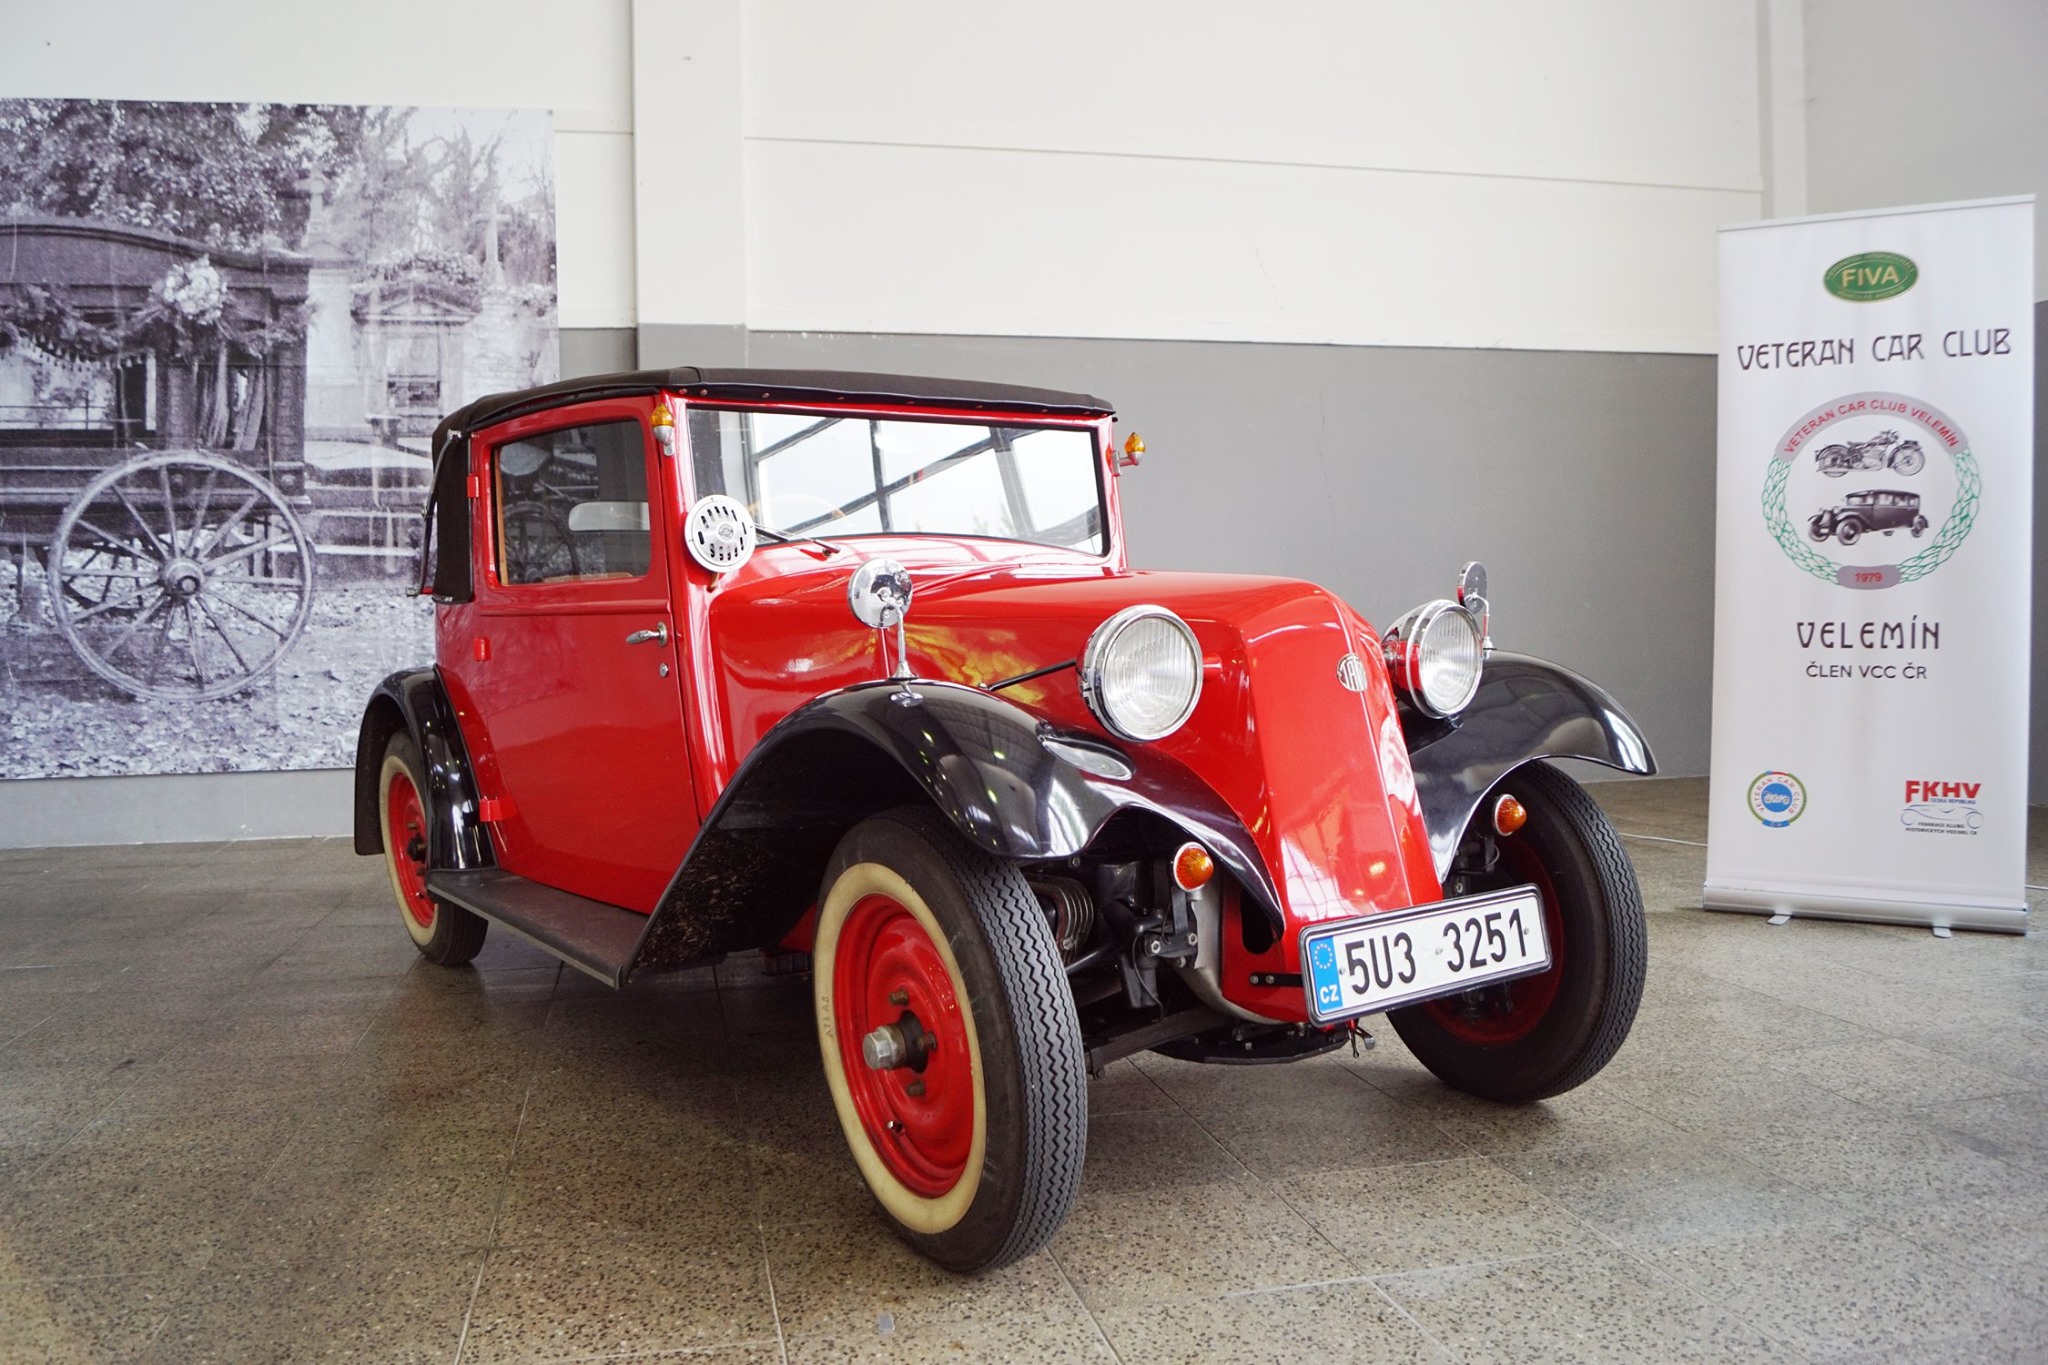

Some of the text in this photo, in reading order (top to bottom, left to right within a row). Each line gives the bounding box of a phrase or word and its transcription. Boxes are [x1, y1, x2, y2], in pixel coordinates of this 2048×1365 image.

[1841, 265, 1900, 288] FIVA
[1737, 328, 2012, 371] VETERAN CAR CLUB
[1784, 410, 1836, 453] VETERAN
[1838, 400, 1867, 415] CAR
[1869, 399, 1908, 413] CLUB
[1854, 572, 1883, 583] 1979
[1796, 614, 1940, 650] VELEMÍN
[1805, 660, 1928, 680] ČLEN VCC ČR
[1904, 780, 1982, 804] FKHV
[1345, 908, 1527, 996] 5U3 3251
[1319, 984, 1340, 1005] CZ
